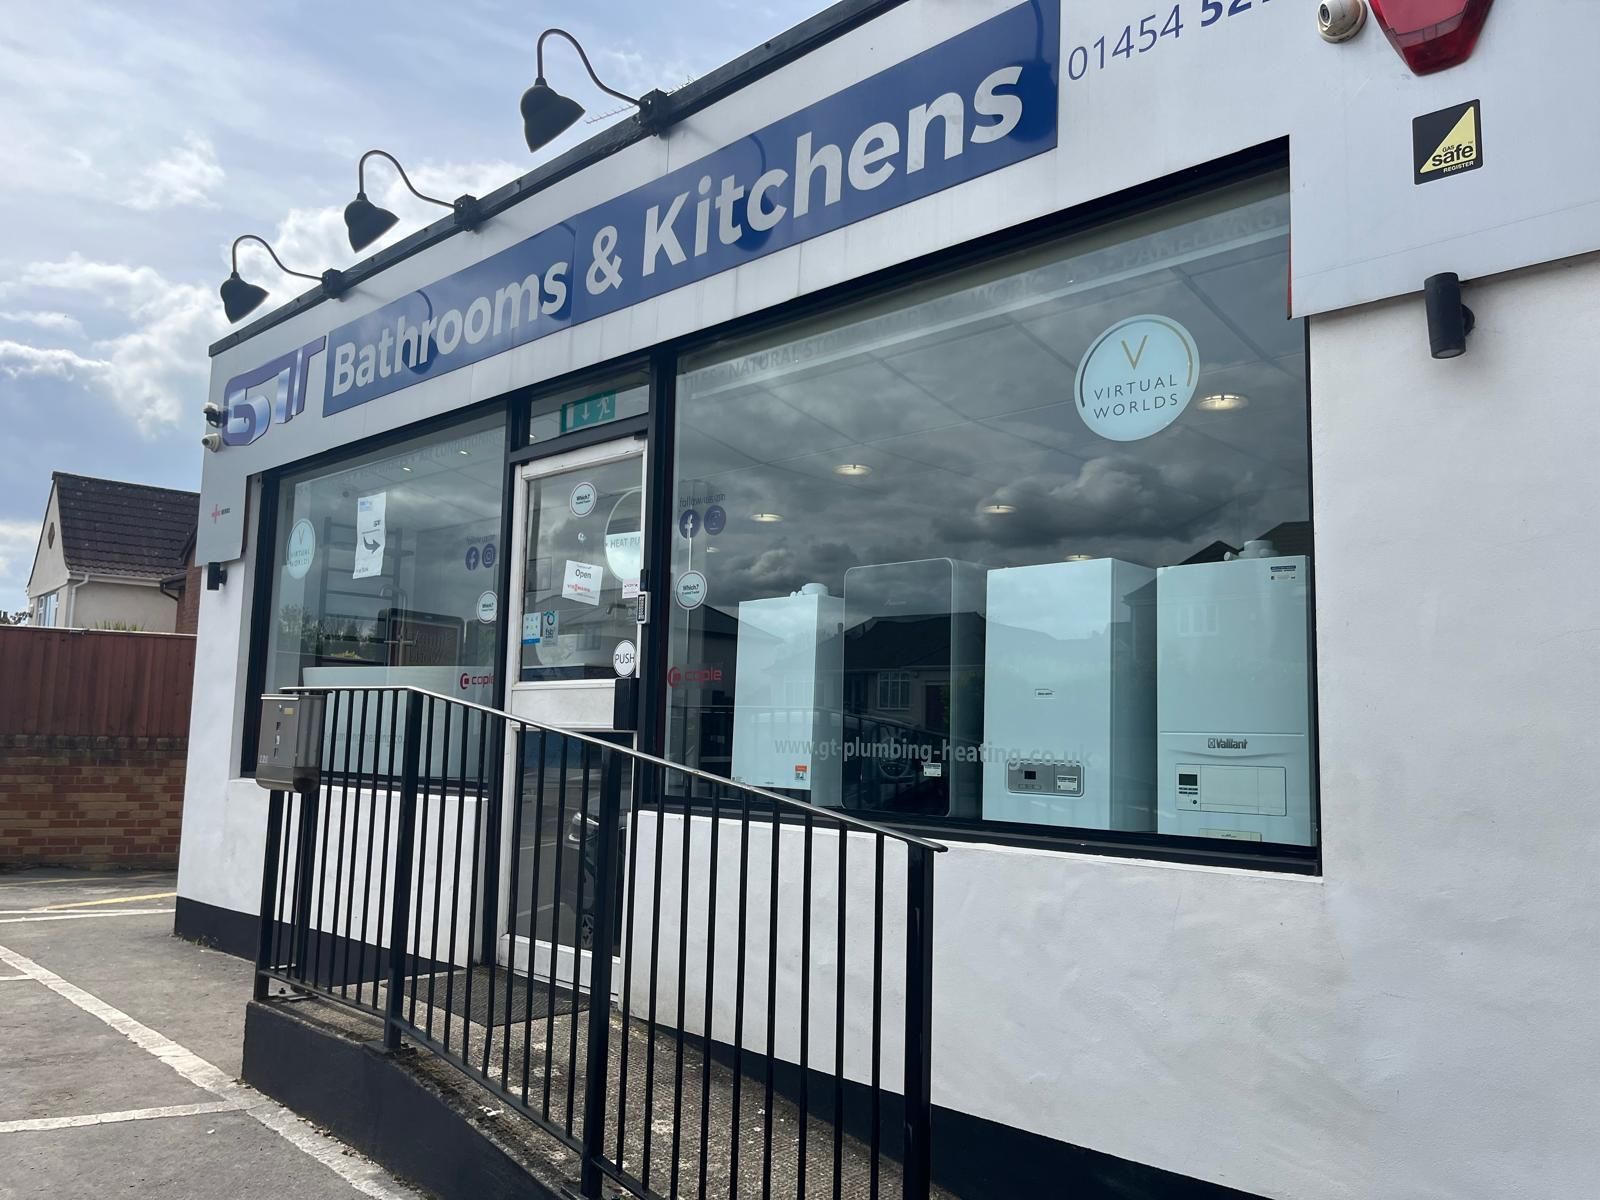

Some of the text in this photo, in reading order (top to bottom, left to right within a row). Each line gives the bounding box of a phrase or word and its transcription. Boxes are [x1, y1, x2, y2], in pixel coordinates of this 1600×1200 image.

[1067, 3, 1184, 81] 01454
[1431, 143, 1474, 167] safe
[1442, 144, 1455, 153] GAS
[1443, 160, 1474, 173] REGISTER
[332, 65, 1024, 397] Bathrooms & Kitchens
[729, 345, 799, 378] NATURAL
[223, 335, 327, 446] GT
[1094, 374, 1177, 401] VIRTUAL
[1093, 393, 1178, 420] WORLDS
[576, 493, 591, 502] Which?
[610, 538, 627, 549] HEAT
[575, 568, 592, 580] Open
[682, 583, 700, 592] Which?
[614, 653, 635, 664] PUSH
[1216, 738, 1248, 750] Vaillant
